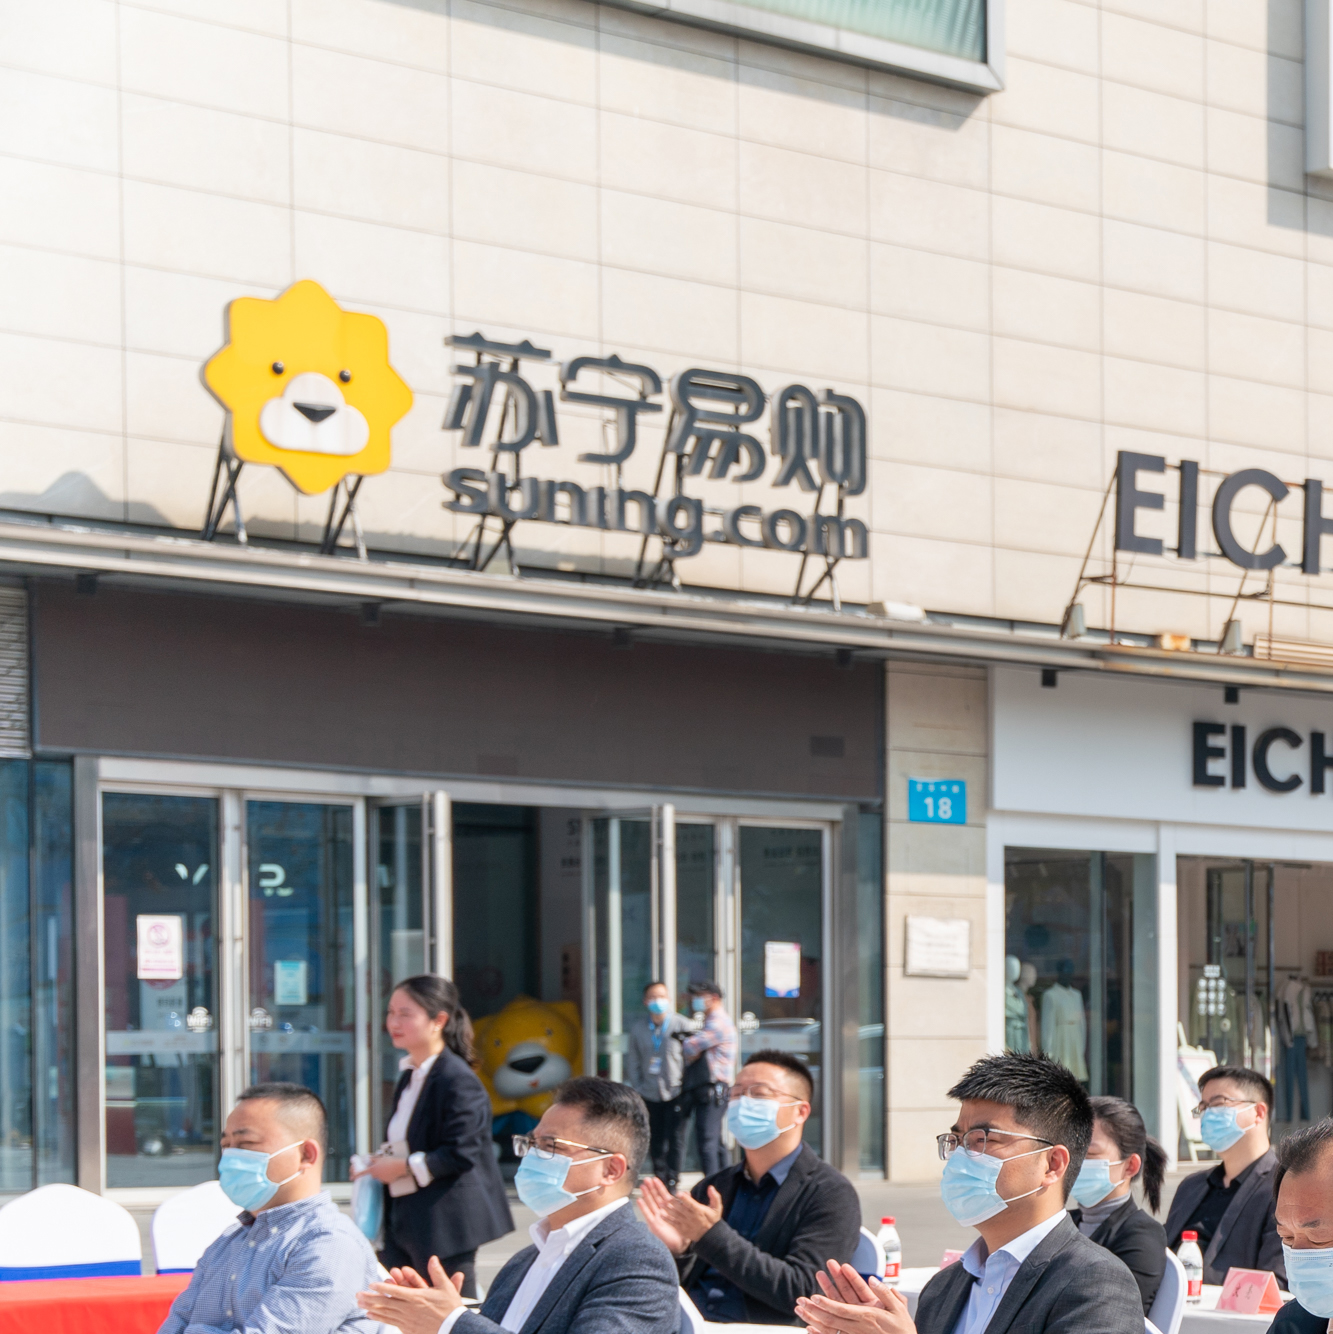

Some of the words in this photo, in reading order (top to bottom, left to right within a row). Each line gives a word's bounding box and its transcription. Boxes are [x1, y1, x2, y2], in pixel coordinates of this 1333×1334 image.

[442, 331, 870, 495] 苏宁易购
[442, 467, 870, 558] suning.com
[924, 797, 953, 820] 18
